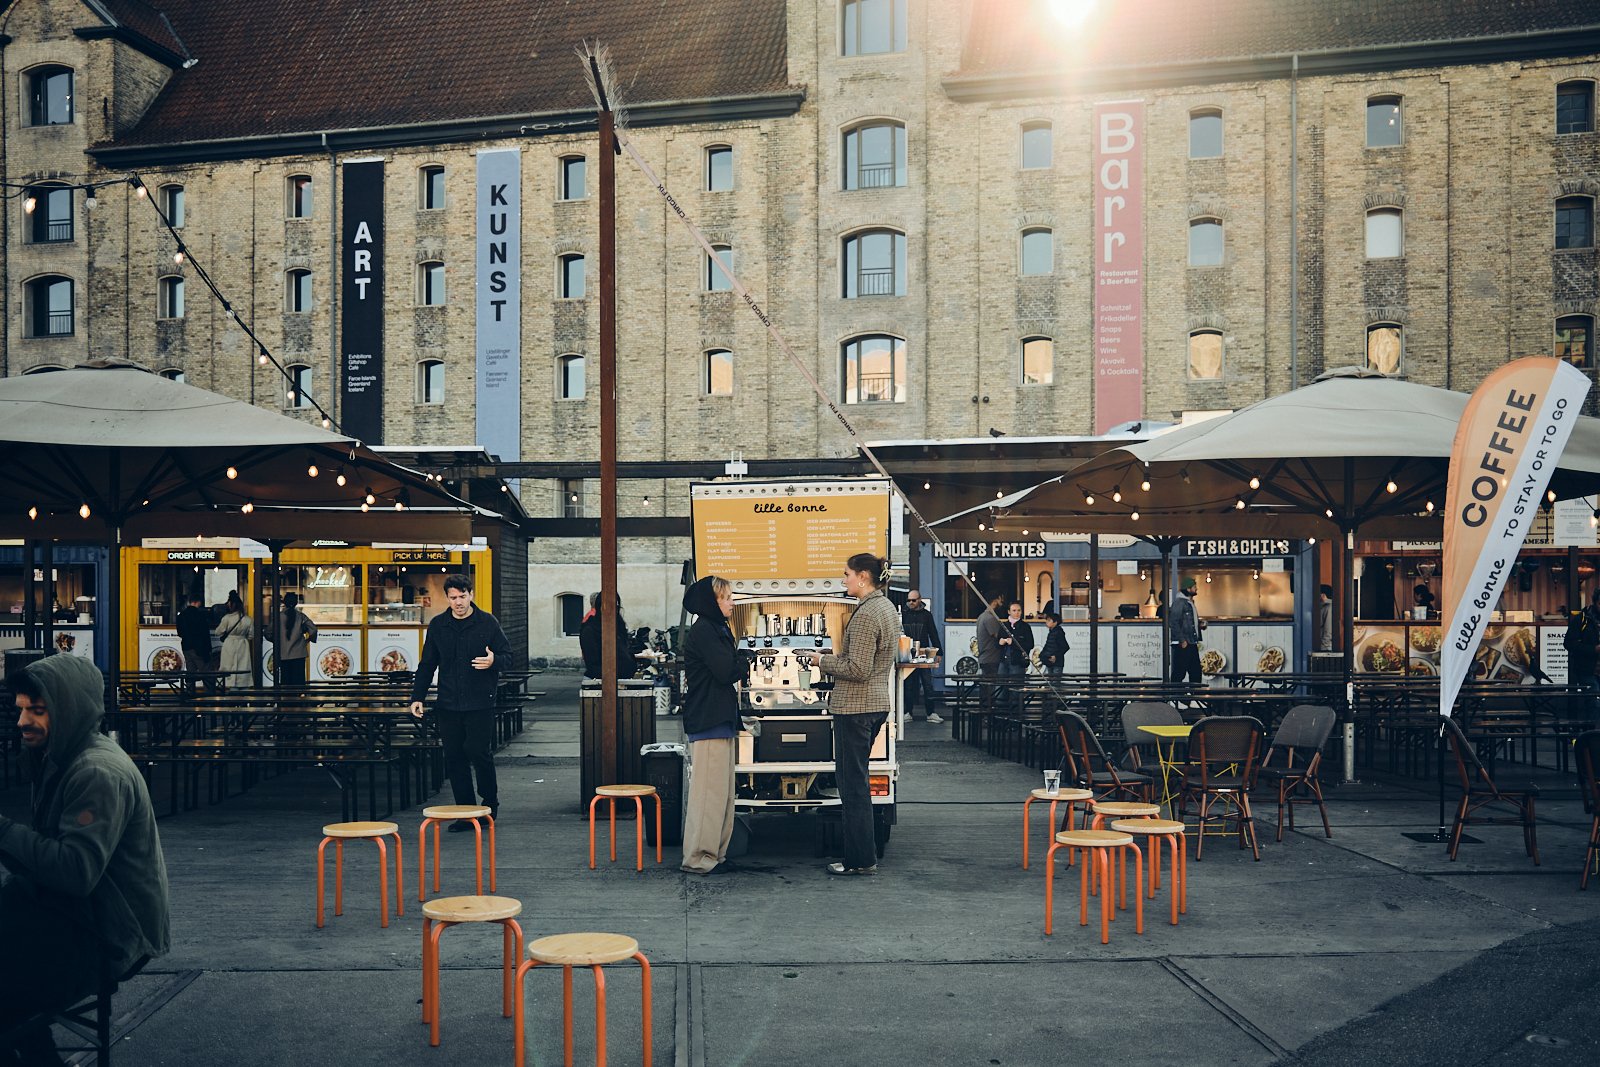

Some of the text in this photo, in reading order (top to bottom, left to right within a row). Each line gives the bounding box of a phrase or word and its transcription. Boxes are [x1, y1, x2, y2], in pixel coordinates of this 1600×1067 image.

[1100, 112, 1135, 263] Barr
[656, 183, 686, 219] CARGO FIX
[489, 183, 508, 322] KUNST
[353, 221, 373, 300] ART
[1100, 269, 1139, 277] Restaurant
[1100, 304, 1132, 312] Schnitzel
[751, 304, 771, 328] CARGO
[1100, 314, 1137, 322] Frikadeller
[1100, 326, 1122, 334] Snaps
[1100, 336, 1121, 344] Beers
[1106, 367, 1139, 375] Cocktails
[1461, 388, 1537, 528] COFFEE
[1503, 398, 1568, 539] TO STAY OR TO GO
[754, 503, 784, 513] lille
[934, 542, 1045, 557] MOULES FRITES
[195, 551, 216, 559] HERE
[394, 552, 412, 560] PICK
[1127, 631, 1145, 639] Fresh
[1455, 614, 1481, 651] lille
[1127, 641, 1161, 649] Every Day
